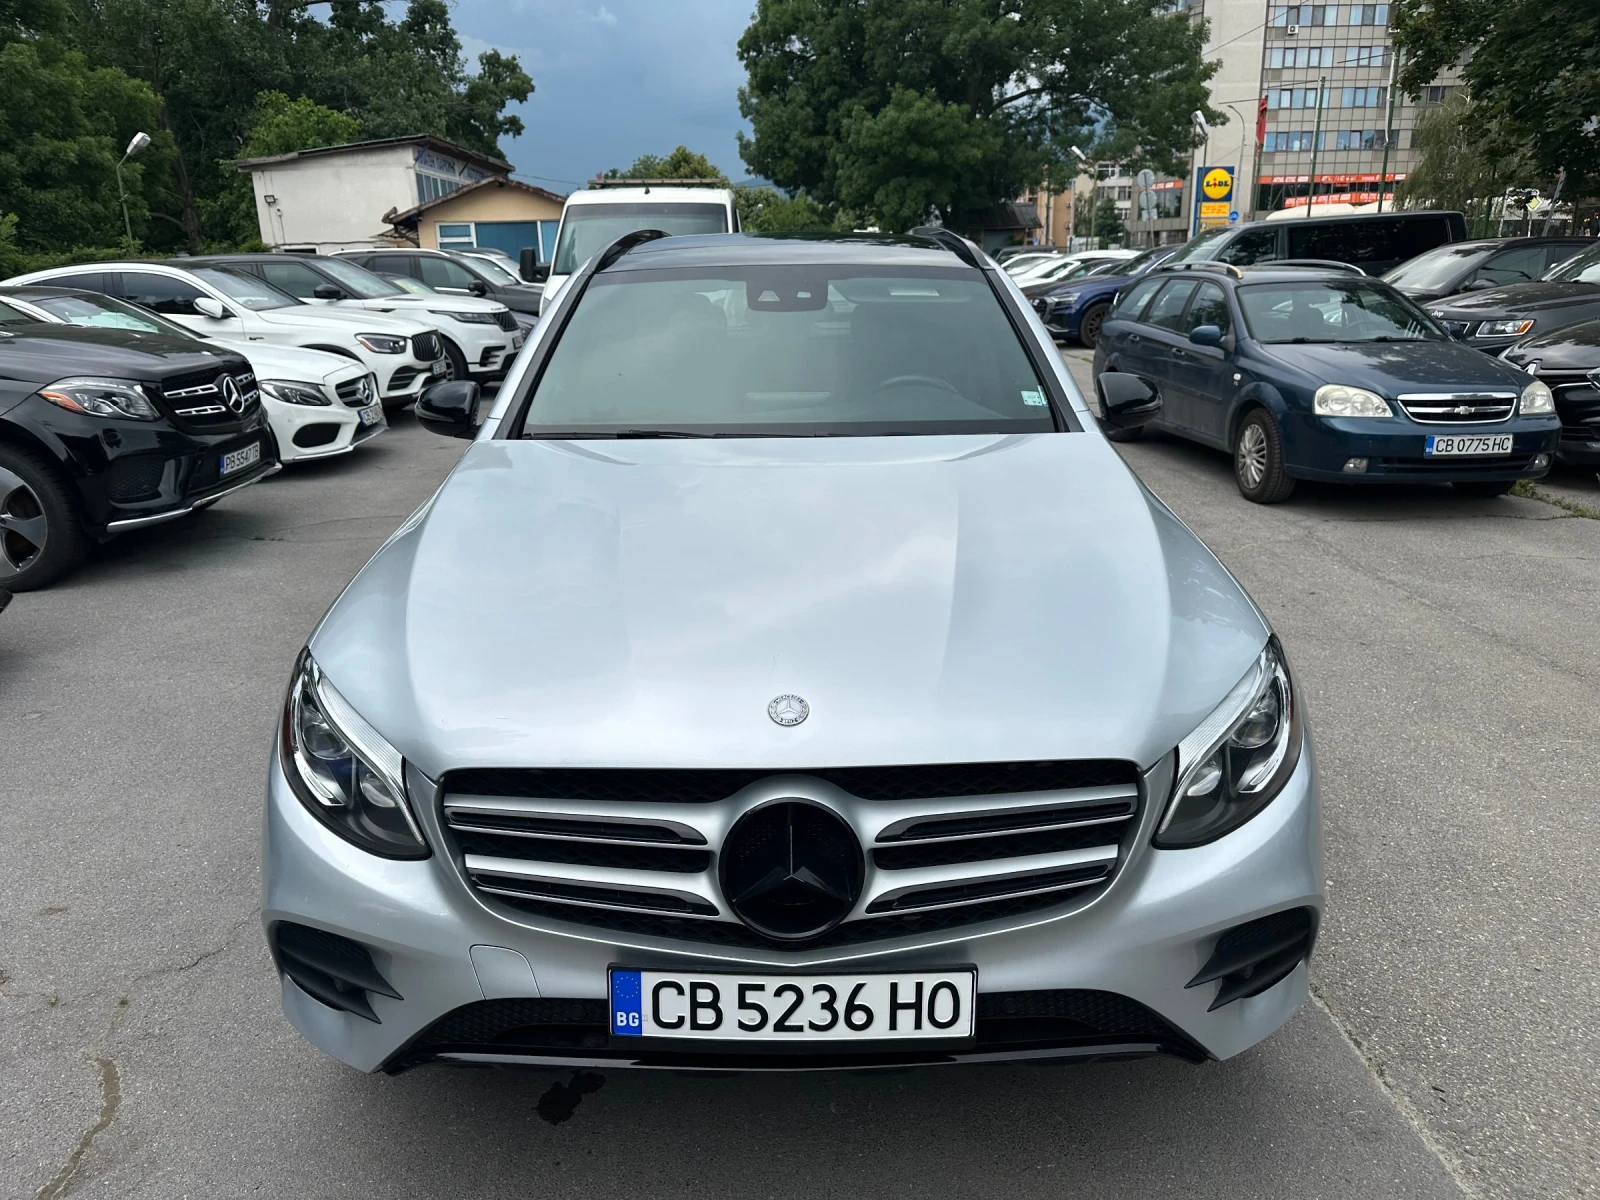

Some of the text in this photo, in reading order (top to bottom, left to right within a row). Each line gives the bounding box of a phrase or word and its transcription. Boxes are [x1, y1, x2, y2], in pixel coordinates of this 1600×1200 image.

[1435, 438, 1454, 453] CB
[1457, 438, 1490, 452] 0775
[1491, 437, 1510, 451] HC
[225, 454, 236, 470] PB
[236, 447, 252, 467] 5547
[616, 979, 961, 1033] BG CB 5236 HO
